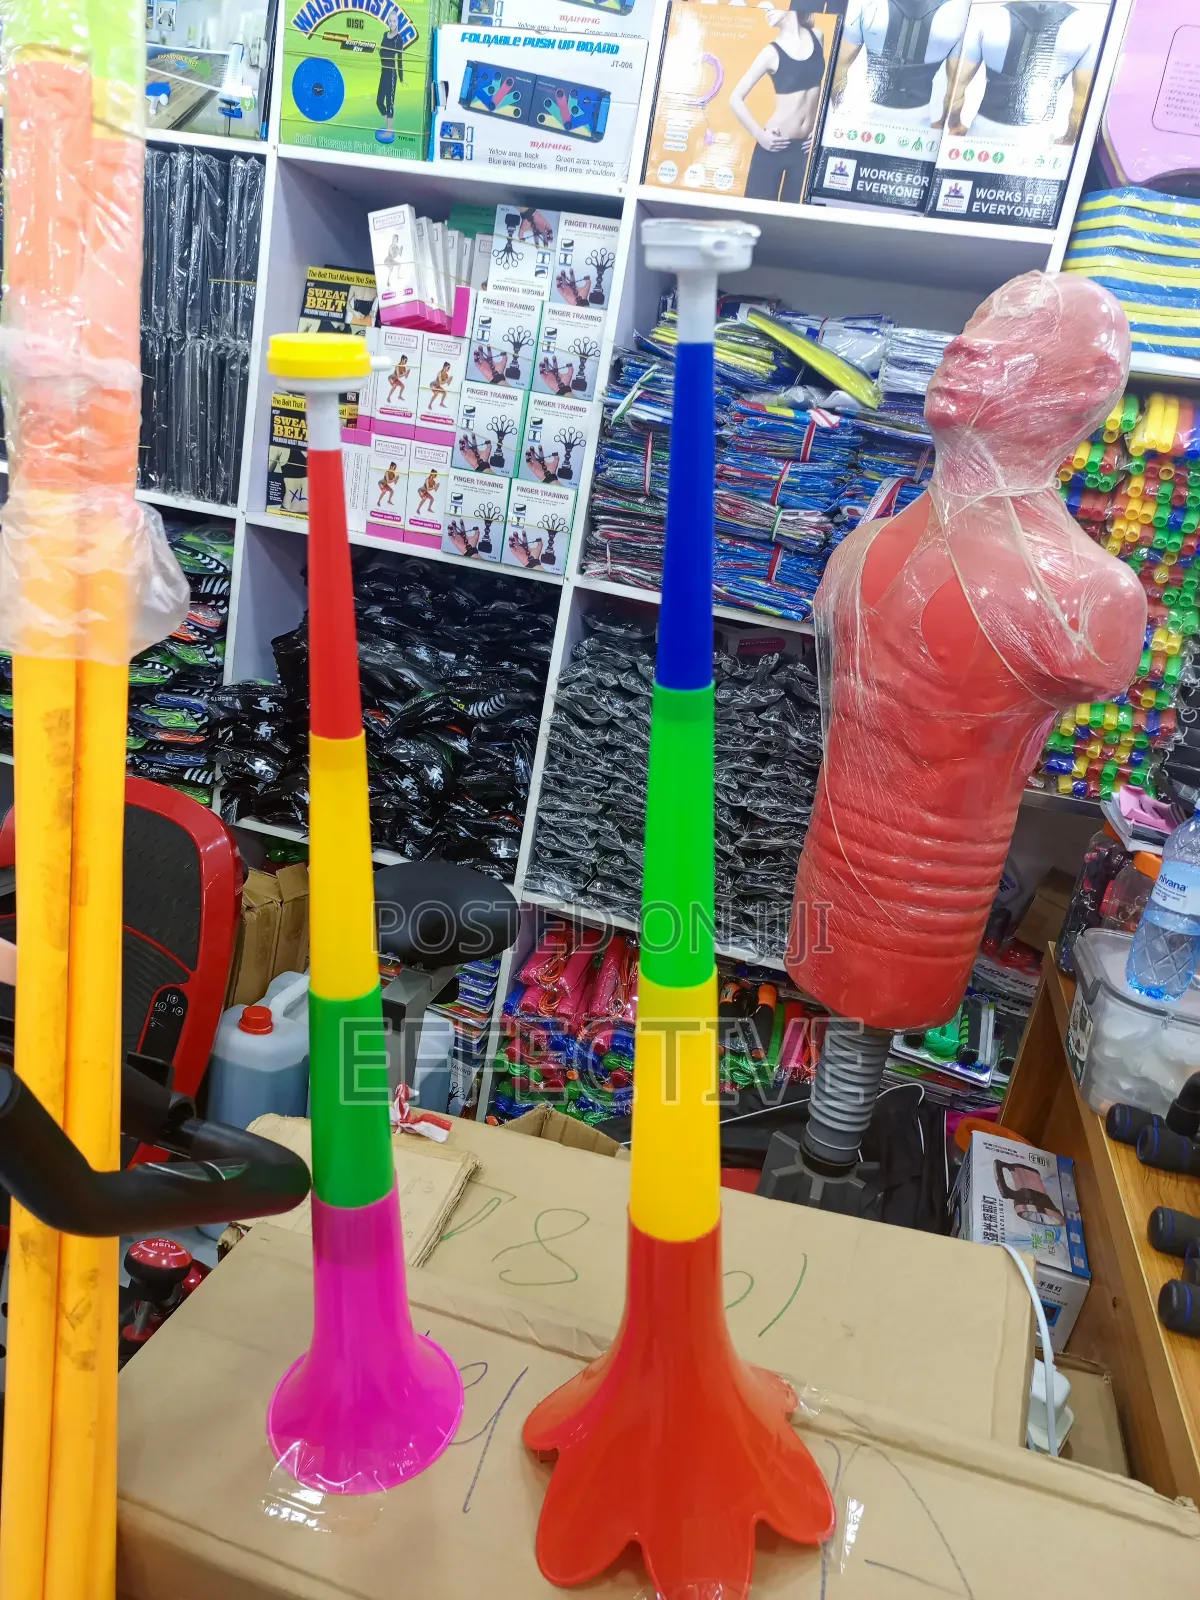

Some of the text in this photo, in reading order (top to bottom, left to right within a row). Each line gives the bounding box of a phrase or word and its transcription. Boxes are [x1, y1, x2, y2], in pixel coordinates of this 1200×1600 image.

[346, 18, 364, 29] DISC
[522, 37, 557, 50] PUSH
[557, 39, 575, 51] UP
[575, 40, 620, 56] BOARD
[611, 60, 633, 69] JT-006
[530, 140, 572, 152] TRAINING
[488, 147, 507, 156] Yellow
[524, 152, 540, 160] back
[488, 157, 502, 165] Blue
[518, 160, 548, 171] pectoralis
[556, 155, 614, 169] Green area: triceps
[555, 164, 568, 173] Red
[585, 167, 616, 178] shoulders
[860, 167, 930, 187] WORKS FOR
[856, 180, 925, 200] EVERYONE!
[975, 187, 1052, 206] WORKS FOR
[972, 201, 1046, 219] EVERYONE!
[564, 219, 619, 233] FINGER TRAINING
[308, 269, 317, 278] The
[317, 271, 327, 279] Belt
[339, 273, 355, 283] Makes
[355, 275, 365, 284] You
[307, 287, 348, 301] SWEAT
[492, 284, 545, 297] FINGER TRAINING
[305, 296, 347, 313] BELT
[482, 297, 506, 308] FINGER
[507, 301, 536, 312] TRAINING
[548, 308, 571, 318] FINGER
[572, 312, 602, 323] TRAINING
[466, 387, 518, 401] FINGER TRAINING
[272, 397, 303, 409] The Belt That
[533, 399, 587, 413] FINGER TRAINING
[273, 415, 308, 430] SWEA
[453, 475, 476, 485] FINGER
[476, 479, 503, 490] TRAINING
[289, 484, 308, 503] XL
[516, 485, 540, 496] FINGER
[540, 490, 569, 501] TRAINING
[1158, 873, 1187, 892] nivana
[1010, 978, 1038, 990] UMP
[151, 1242, 176, 1250] PUSH
